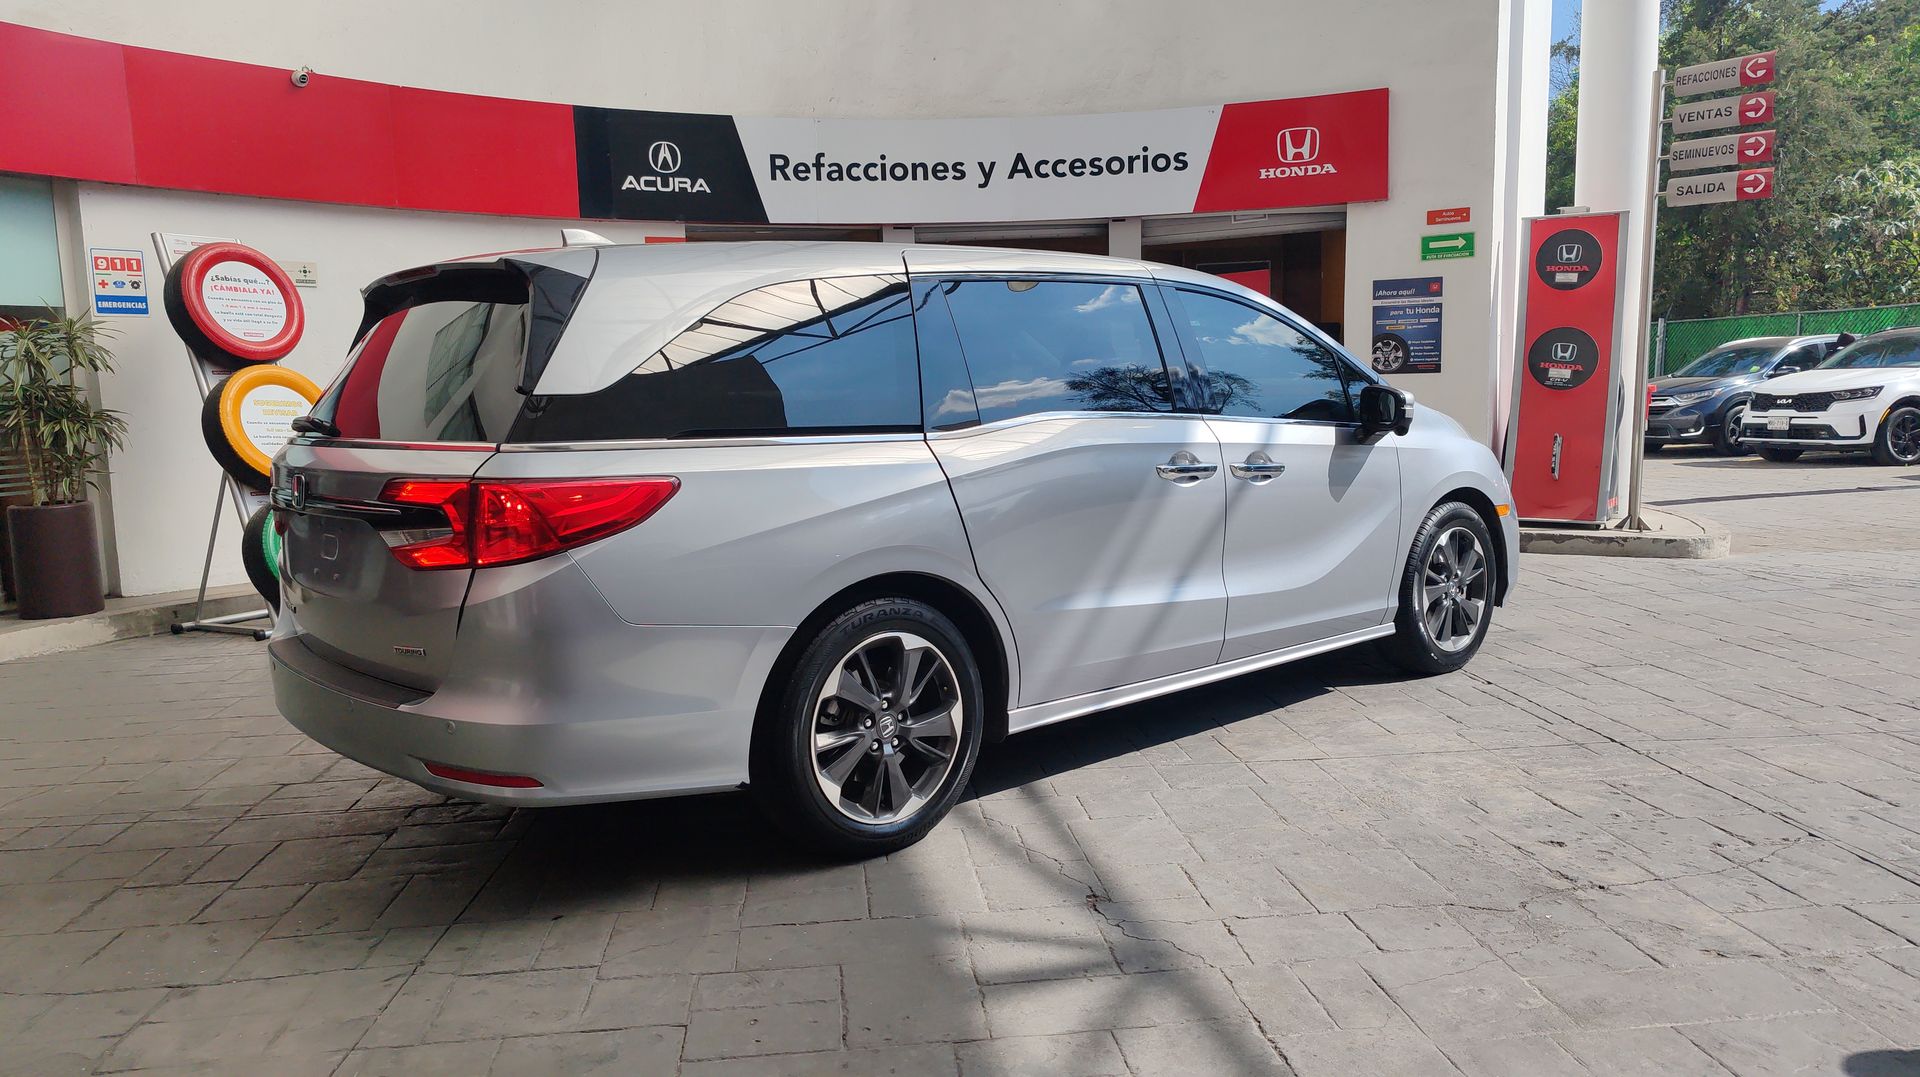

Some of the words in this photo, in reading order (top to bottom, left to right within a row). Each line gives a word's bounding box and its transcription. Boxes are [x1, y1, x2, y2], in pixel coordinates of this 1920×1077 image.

[1676, 66, 1737, 87] REFACCIONES
[1679, 106, 1733, 123] VENTAS
[1672, 144, 1735, 161] SEMINUEVOS
[769, 152, 967, 182] Refacciones
[977, 161, 997, 189] y
[1007, 145, 1189, 180] Accesorios
[1258, 161, 1338, 180] HONDA
[621, 175, 712, 194] ACURA
[1676, 182, 1726, 196] SALIDA
[97, 258, 138, 271] 911
[97, 301, 147, 309] EMERGENCIAS
[1415, 306, 1440, 315] Honda
[1540, 362, 1584, 371] HONDA
[839, 607, 925, 635] TURANZA
